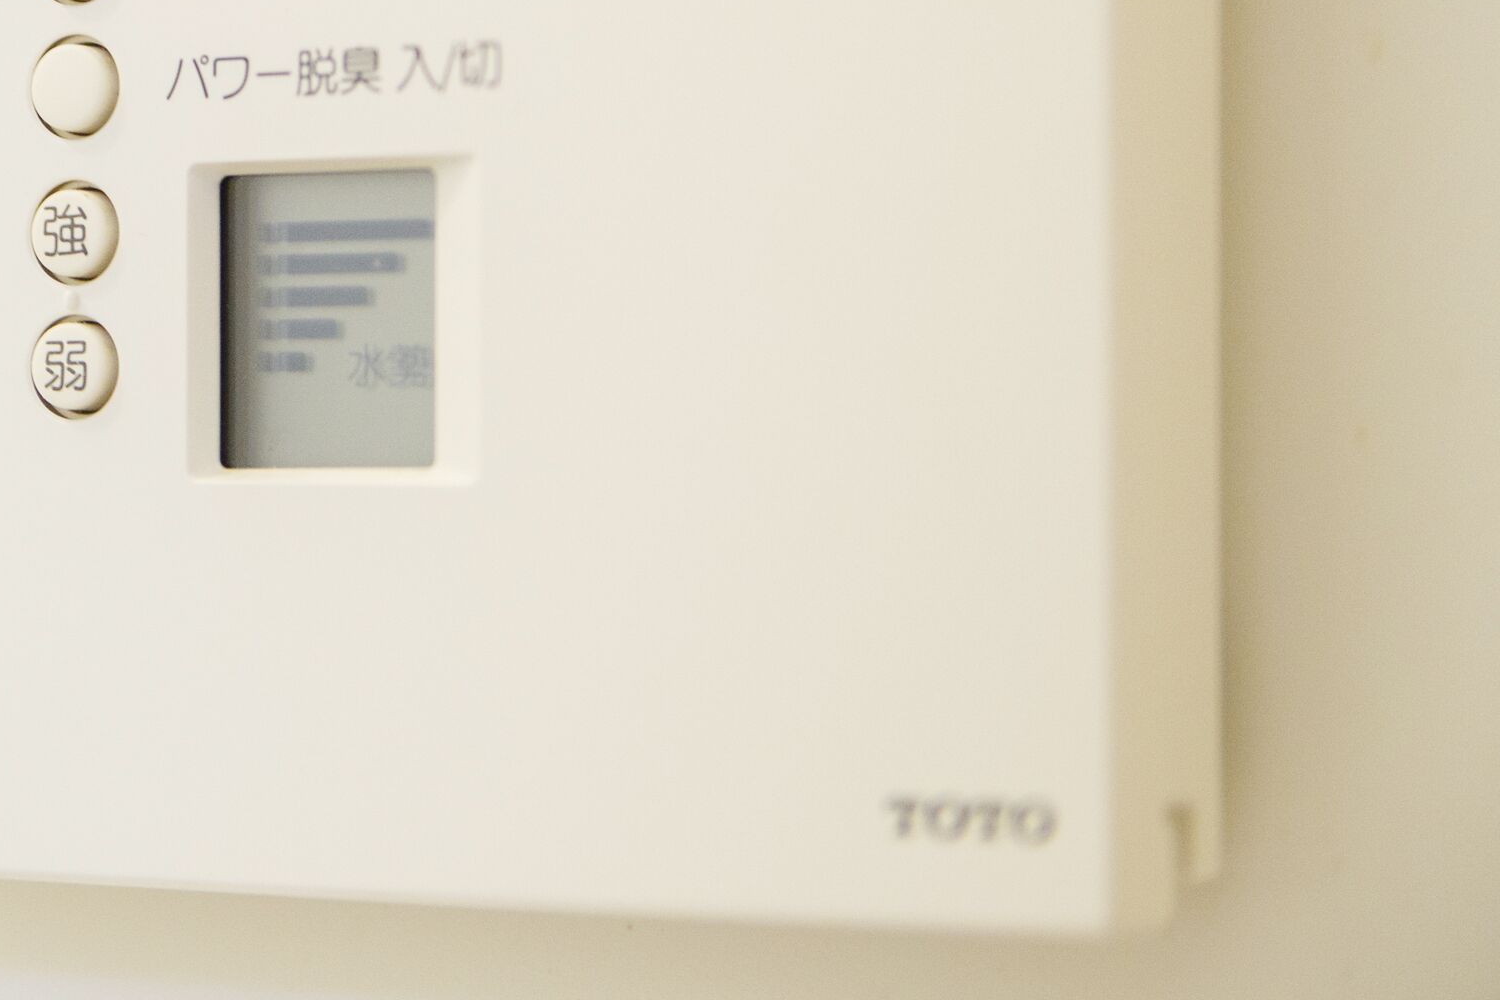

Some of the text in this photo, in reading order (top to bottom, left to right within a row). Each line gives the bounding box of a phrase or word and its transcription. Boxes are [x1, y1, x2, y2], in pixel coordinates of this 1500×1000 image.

[166, 39, 503, 101] パワー脱臭 入/切
[42, 204, 89, 258] 強
[44, 340, 89, 393] 弱
[884, 795, 1057, 847] TOTO
